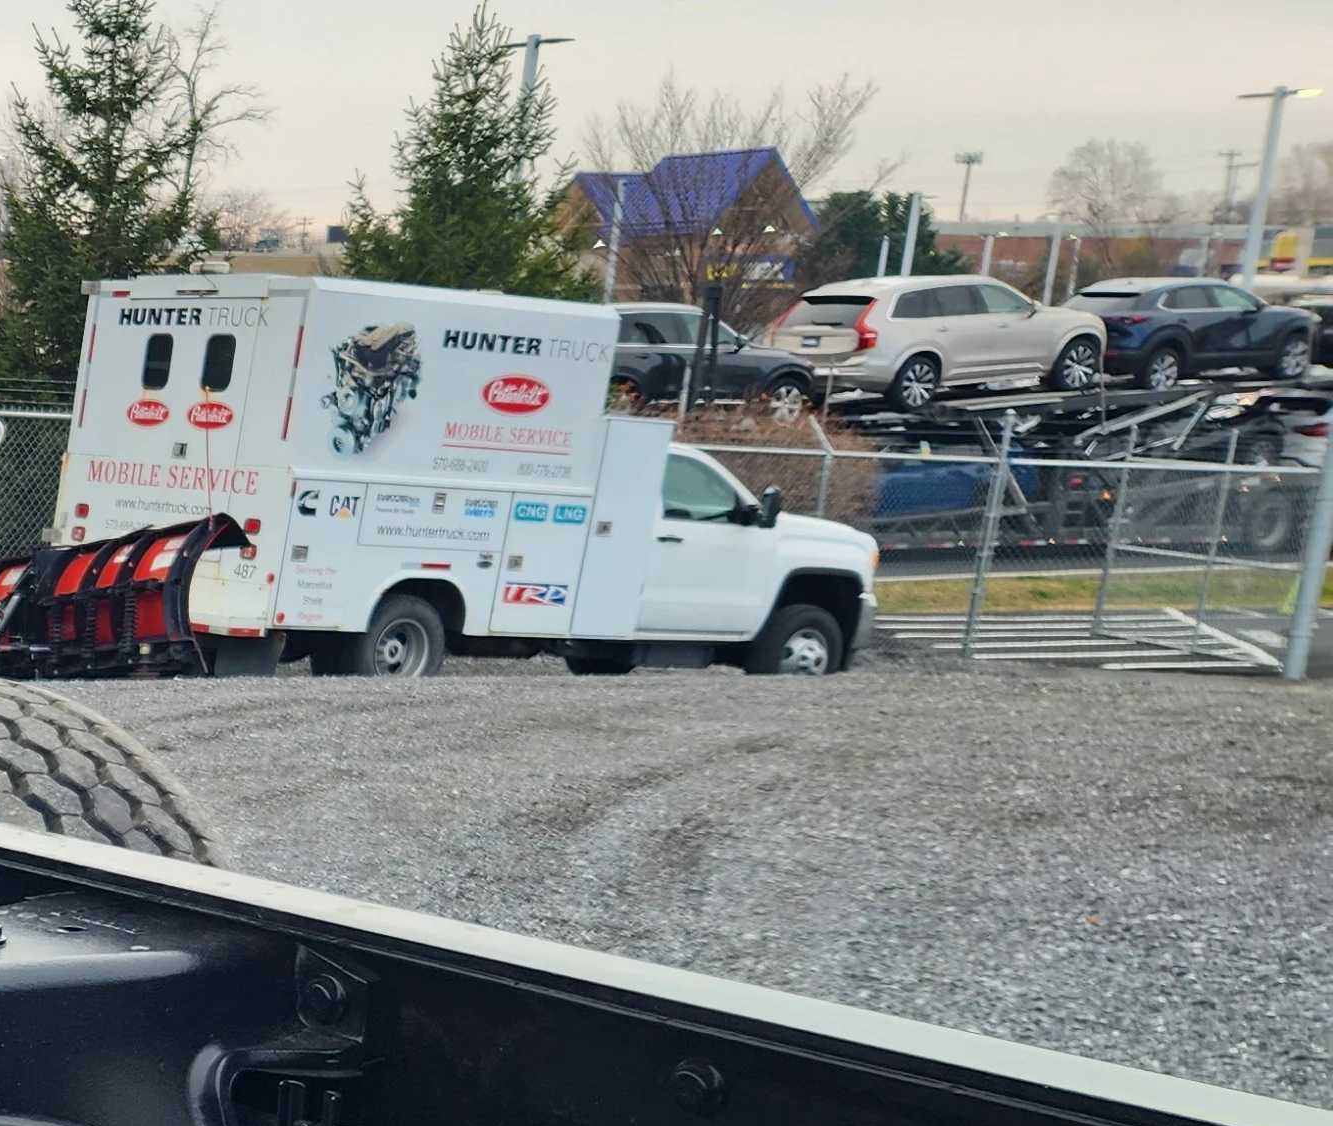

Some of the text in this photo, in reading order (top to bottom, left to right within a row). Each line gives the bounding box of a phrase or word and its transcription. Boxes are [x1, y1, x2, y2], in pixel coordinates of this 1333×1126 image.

[119, 307, 270, 327] HUNTER TRUCK
[442, 329, 612, 363] HUNTER TRUCK
[488, 380, 549, 405] Peterbilt
[444, 422, 573, 448] MOBILE SERVICE
[88, 460, 259, 495] MOBILE SERVICE
[329, 495, 361, 518] CAT
[517, 504, 547, 518] CNG
[555, 506, 583, 520] LNG
[377, 524, 491, 542] www.huntertruck.com
[234, 563, 258, 579] 487
